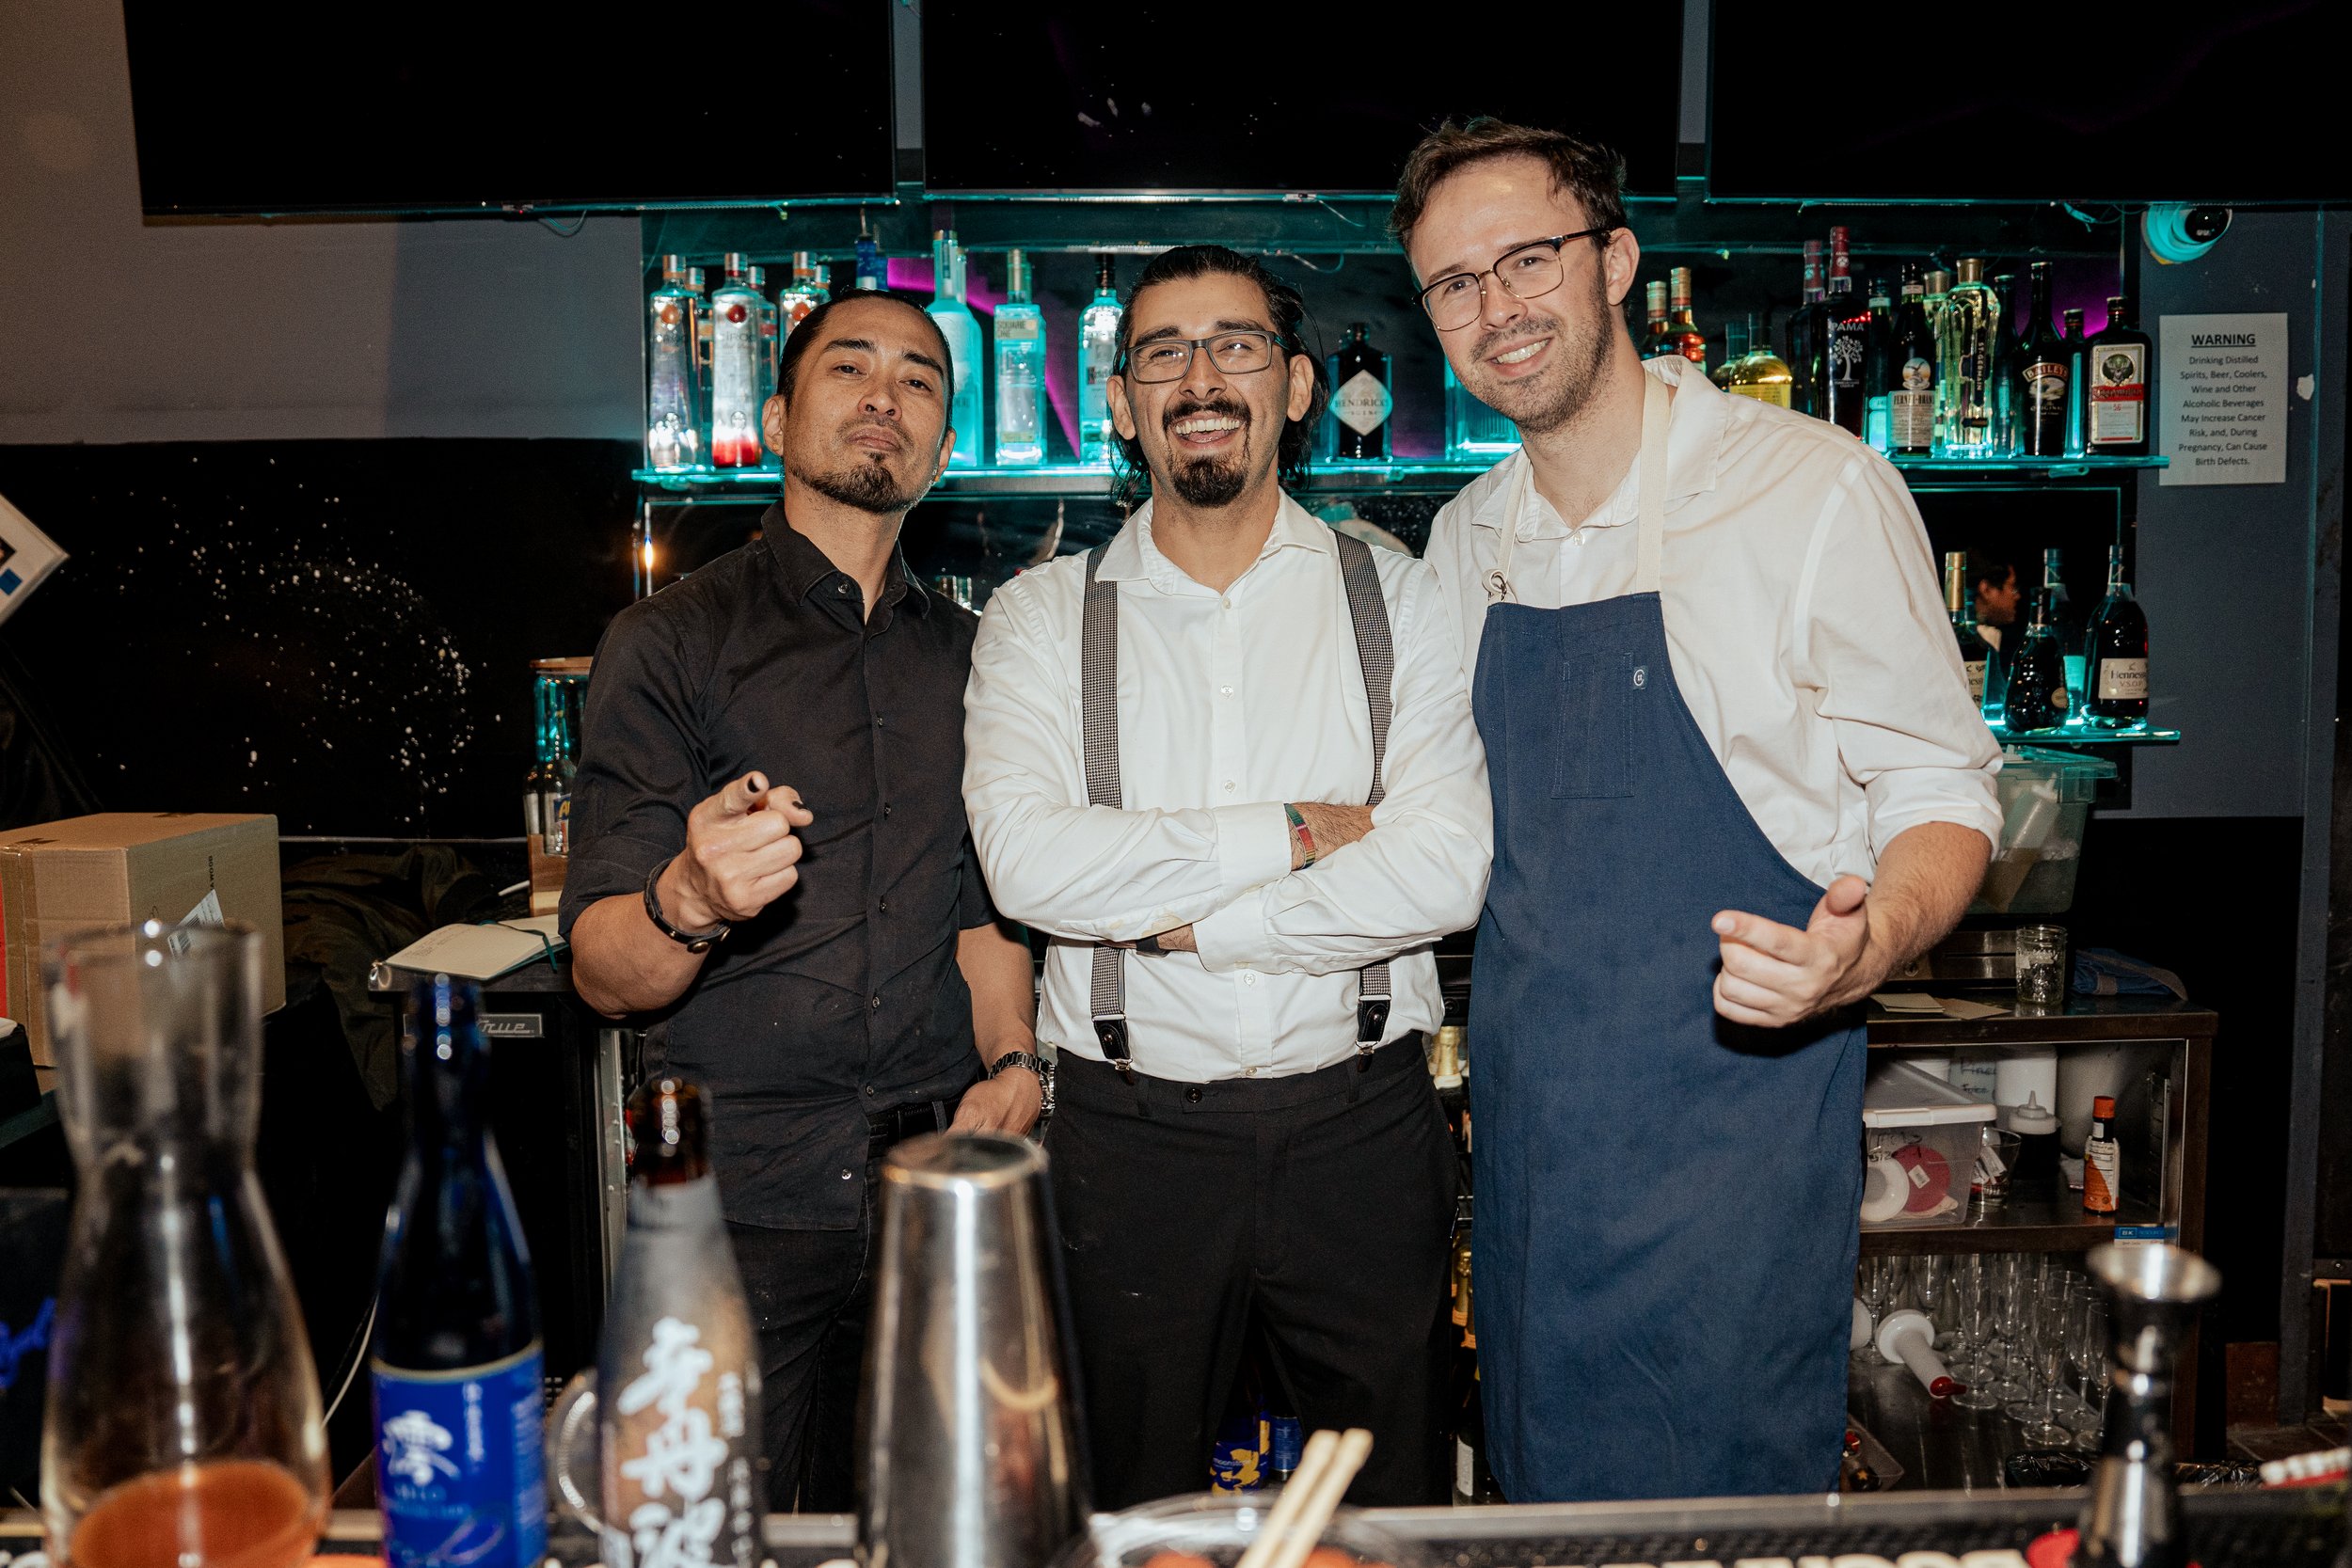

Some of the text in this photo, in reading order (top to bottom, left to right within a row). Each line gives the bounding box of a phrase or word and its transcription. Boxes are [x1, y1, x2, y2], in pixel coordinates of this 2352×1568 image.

[2191, 333, 2256, 346] WARNING
[2189, 356, 2259, 365] Drinking Distilled
[2180, 370, 2267, 380] Spirits, Beer, Coolers,
[2215, 385, 2231, 393] and
[2233, 385, 2257, 393] Other
[2183, 399, 2265, 408] Alcoholic Beverages
[2181, 415, 2200, 423] May
[2201, 414, 2235, 422] Increase
[2189, 429, 2208, 437] Risk,
[2231, 428, 2258, 437] During
[2178, 443, 2224, 452] Pregnancy,
